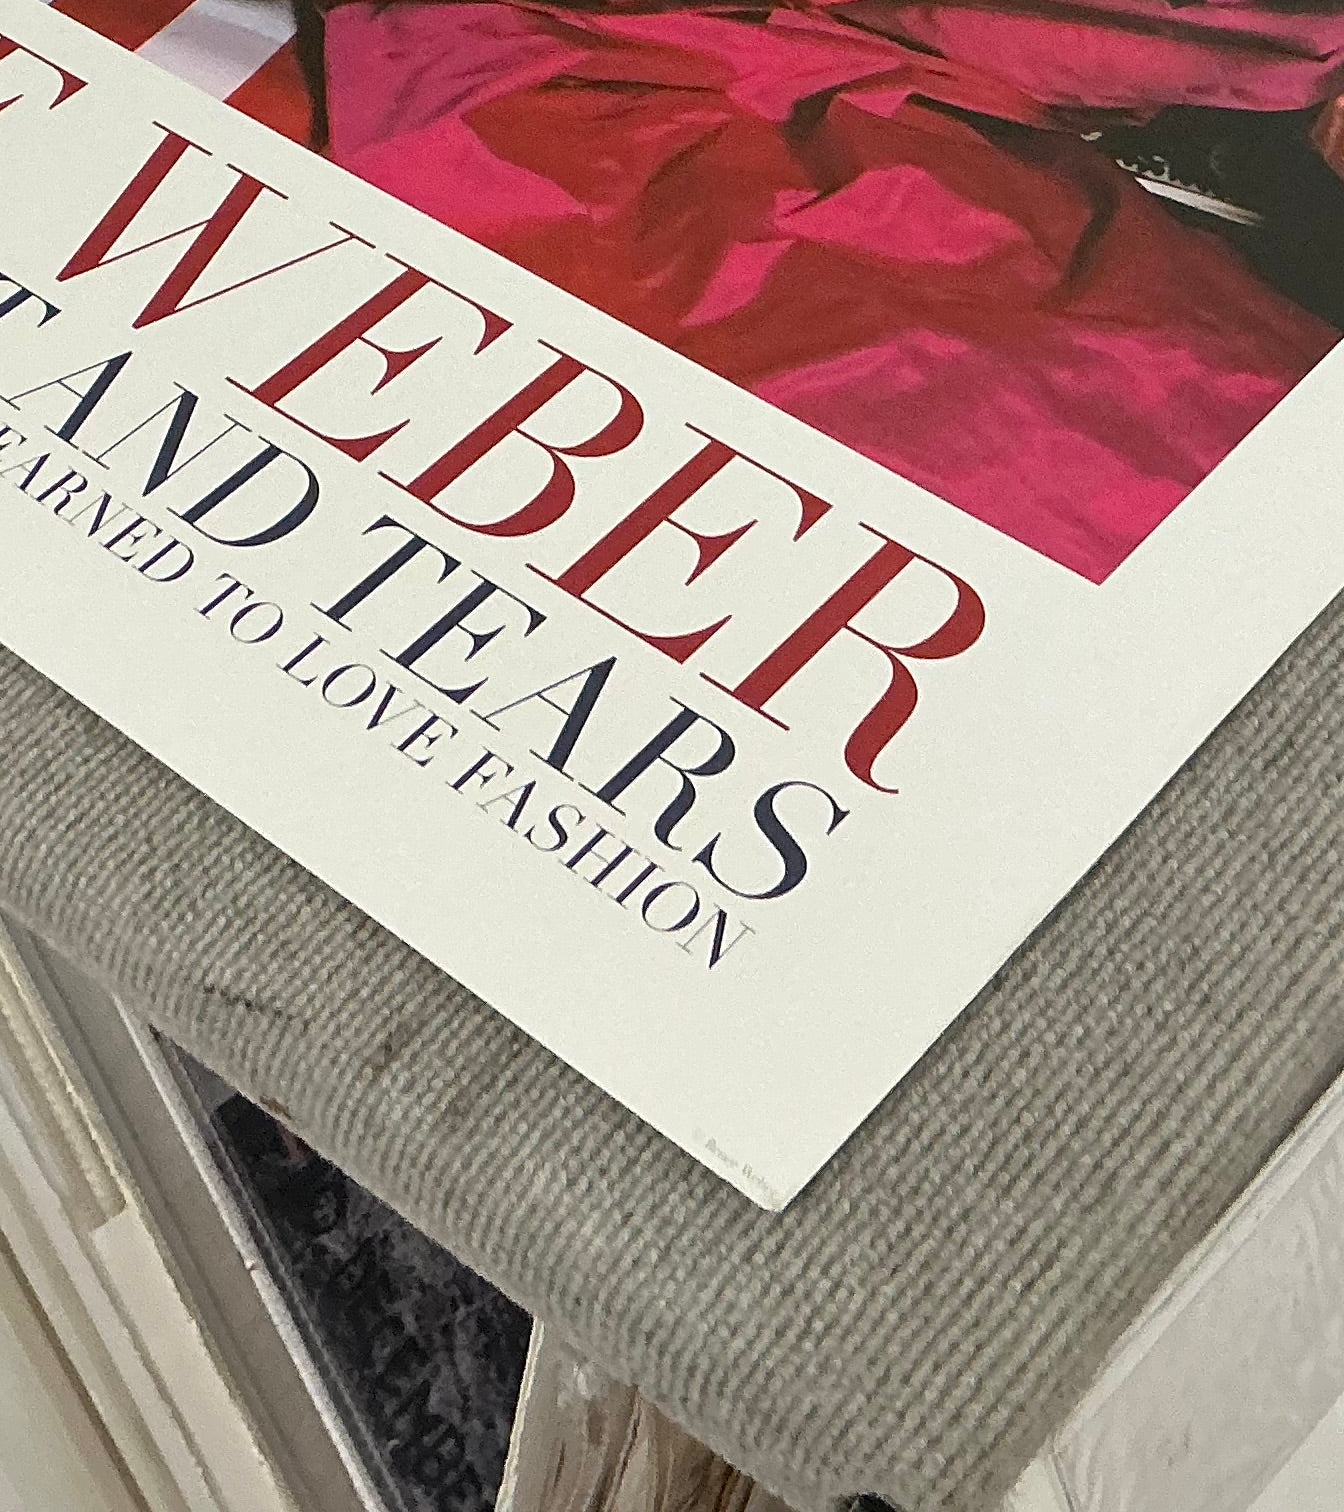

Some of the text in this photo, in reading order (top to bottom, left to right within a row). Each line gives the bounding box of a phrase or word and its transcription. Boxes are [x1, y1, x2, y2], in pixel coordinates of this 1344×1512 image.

[0, 349, 320, 548] AND
[308, 513, 850, 900] TEARS
[54, 119, 986, 794] WEBER
[197, 572, 284, 644] TO
[275, 631, 459, 767] LOVE
[444, 745, 755, 970] FASHION
